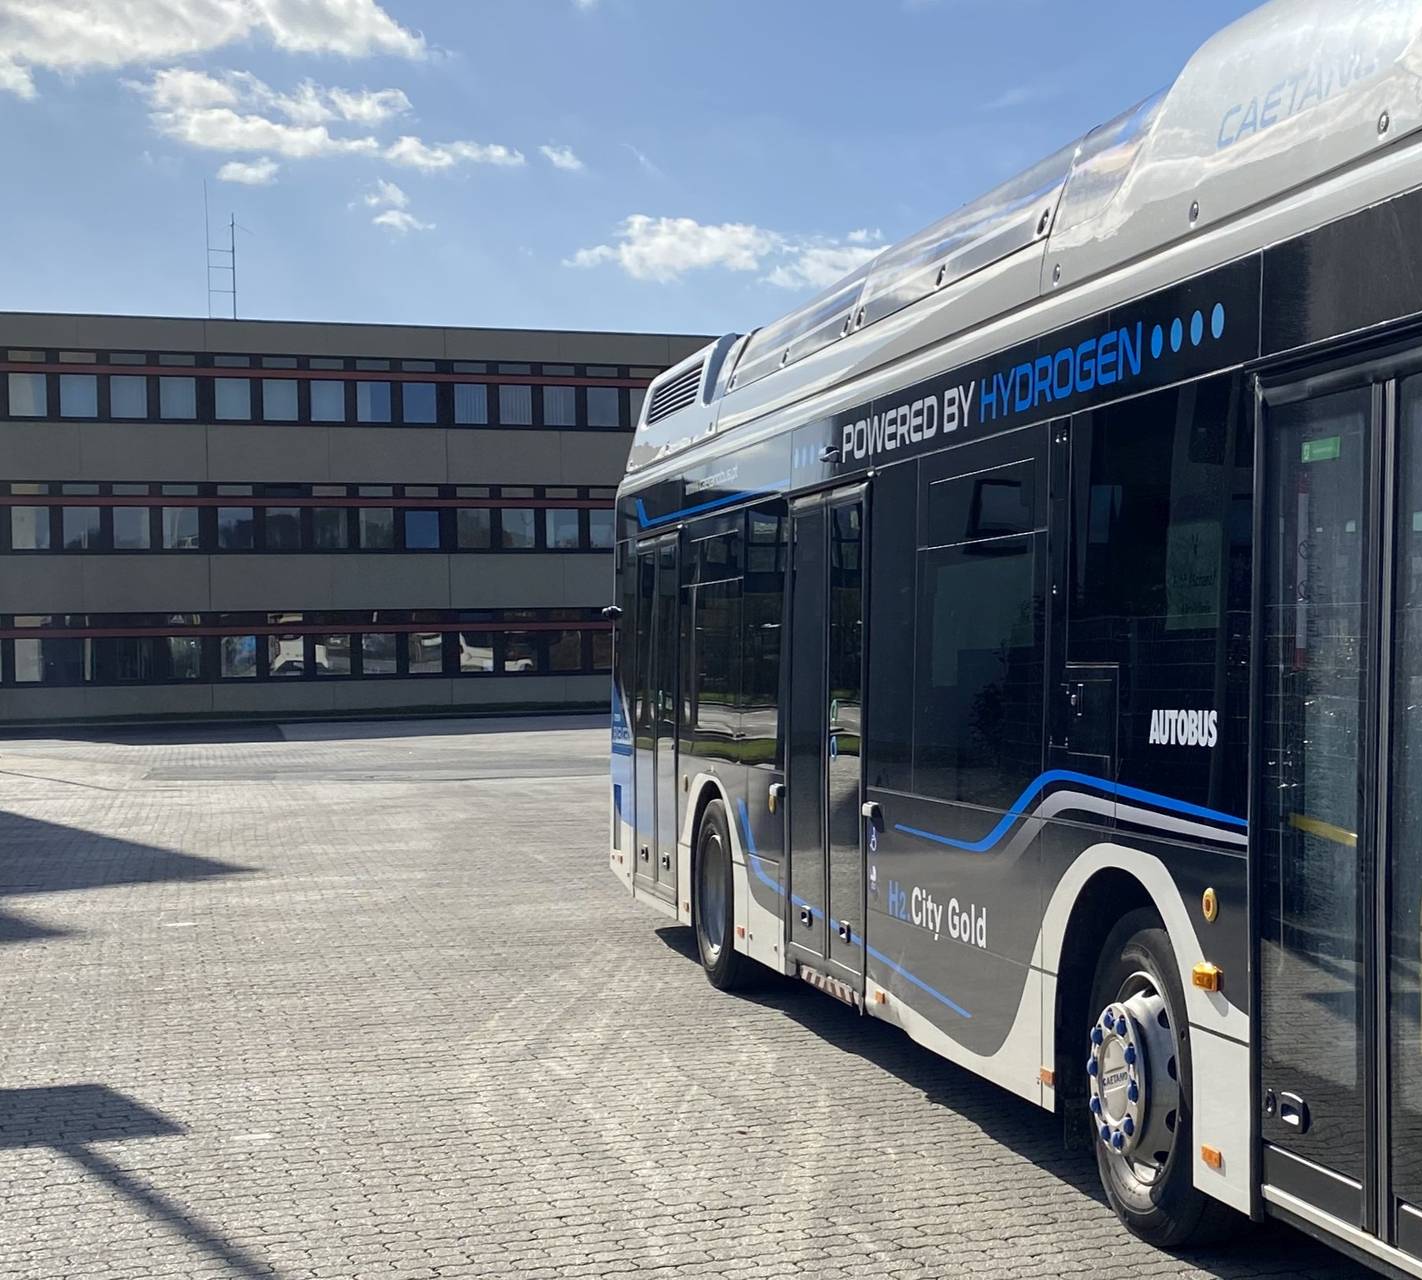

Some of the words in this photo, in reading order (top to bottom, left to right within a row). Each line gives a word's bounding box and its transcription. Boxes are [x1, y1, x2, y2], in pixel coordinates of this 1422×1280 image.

[842, 394, 938, 464] POWERED
[943, 381, 976, 434] BY
[980, 321, 1143, 424] HYDROGEN
[1149, 709, 1218, 747] AUTOBUS
[948, 897, 987, 948] Gold
[1103, 1071, 1128, 1086] CAETANO
